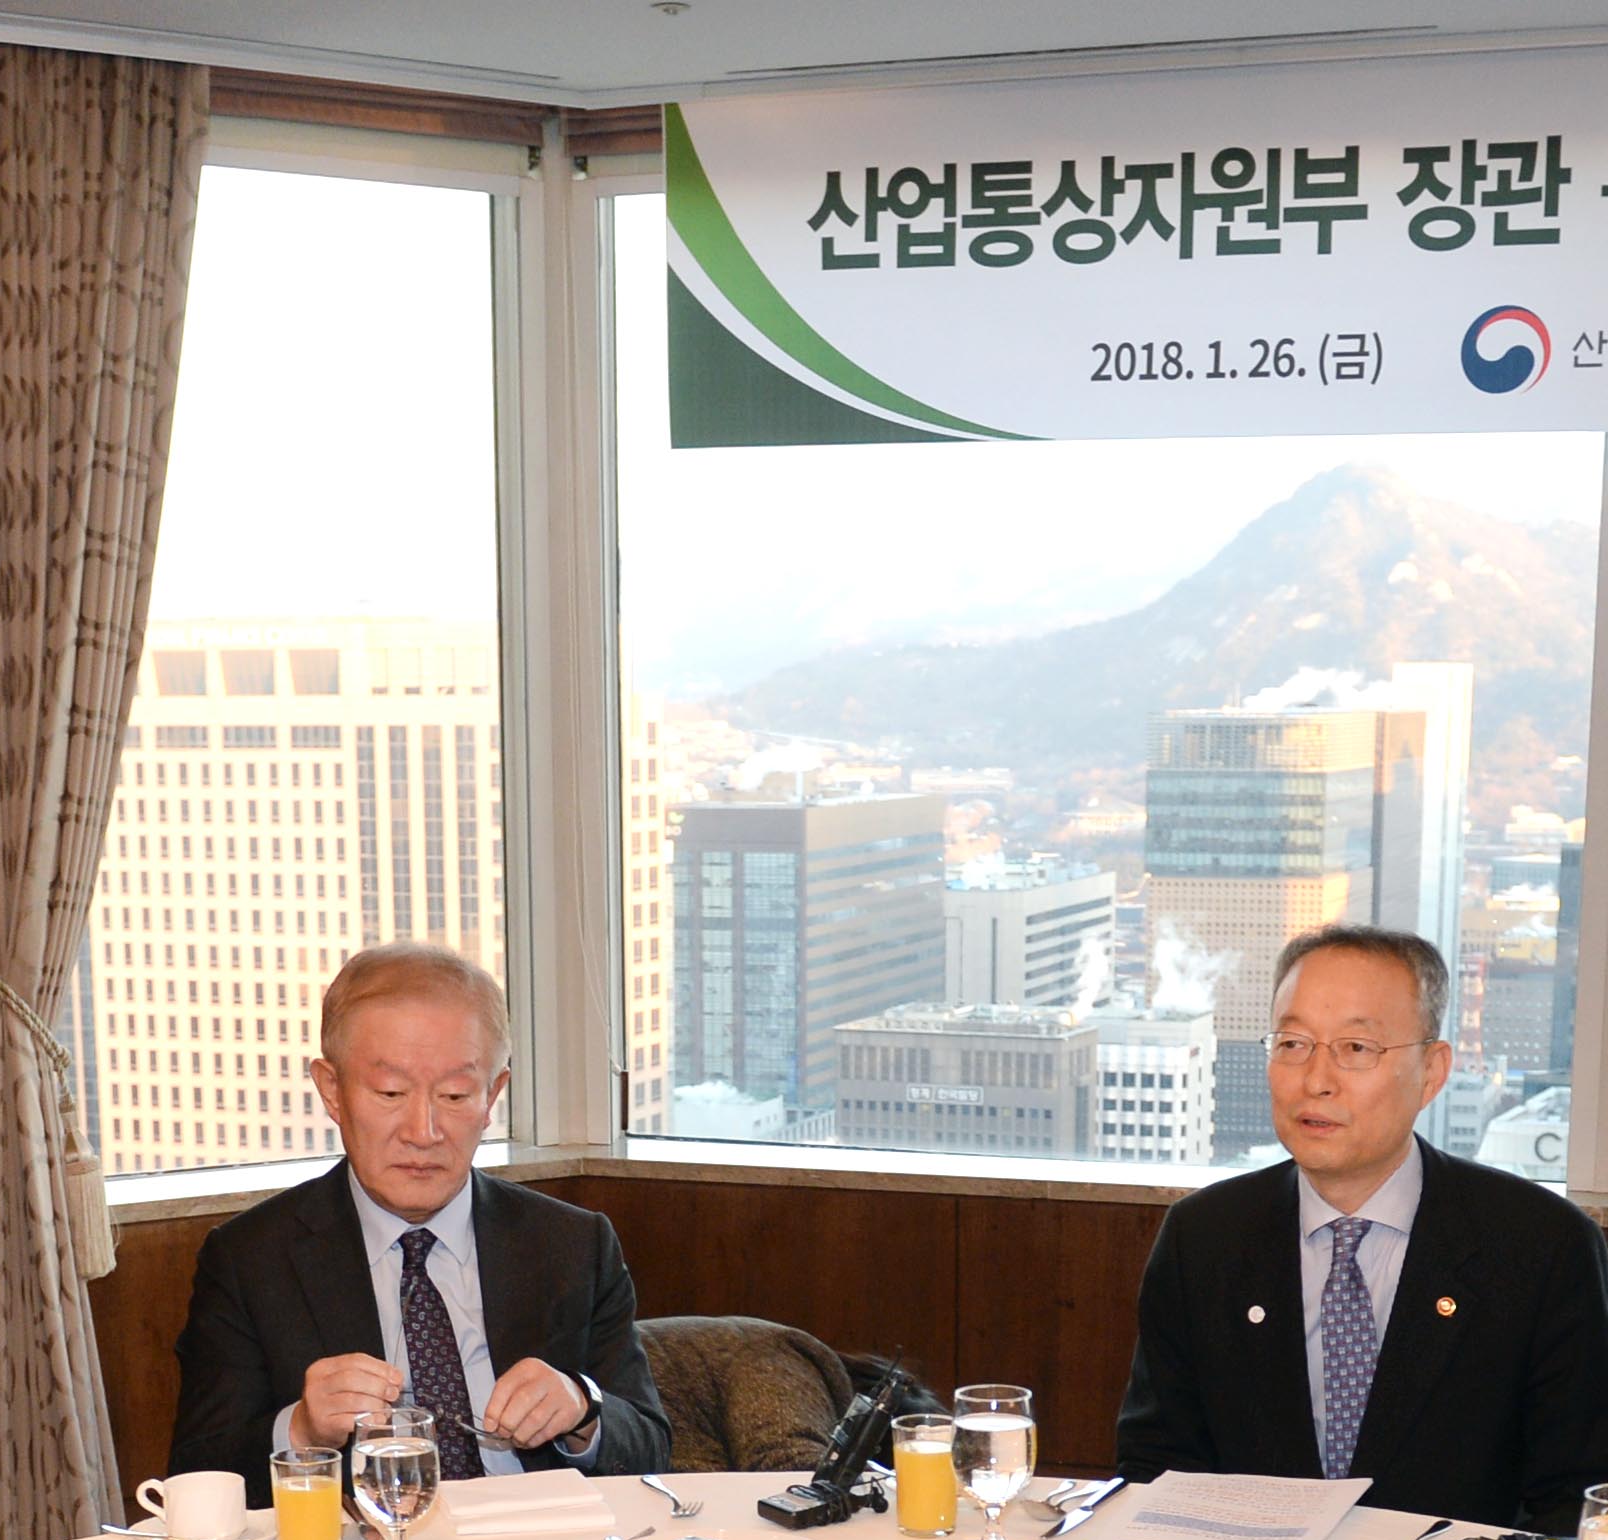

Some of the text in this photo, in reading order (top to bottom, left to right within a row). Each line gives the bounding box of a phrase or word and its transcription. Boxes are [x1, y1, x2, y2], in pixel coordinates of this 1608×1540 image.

[807, 144, 1369, 271] 산업통상자원부
[1396, 134, 1572, 252] 장관
[1090, 332, 1383, 386] 2018. 1. 26. (금)
